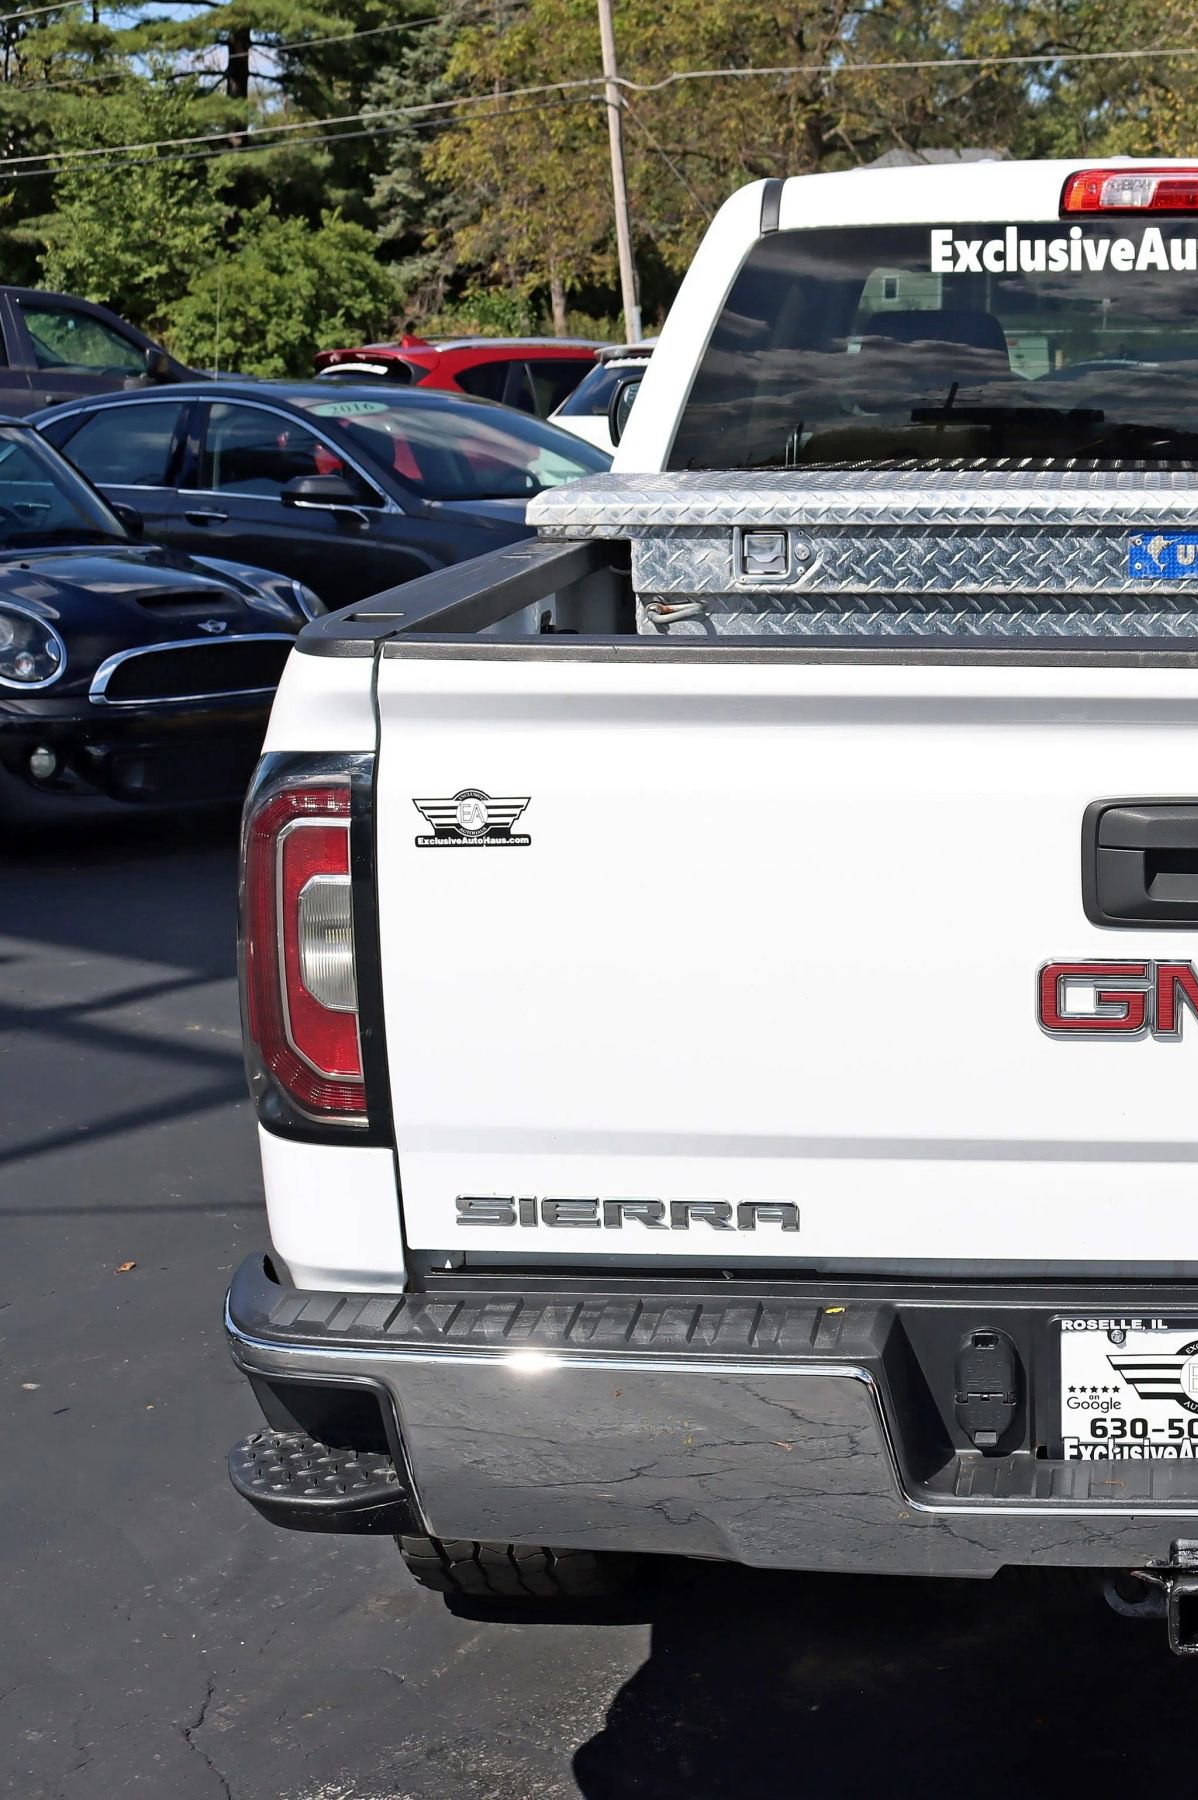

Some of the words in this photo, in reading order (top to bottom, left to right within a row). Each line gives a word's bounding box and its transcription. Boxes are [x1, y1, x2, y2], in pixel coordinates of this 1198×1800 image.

[331, 403, 375, 415] 2016
[456, 1194, 801, 1232] SIERRA
[1061, 1319, 1146, 1330] ROSELLE,
[1151, 1319, 1168, 1329] IL
[1066, 1397, 1122, 1413] Google
